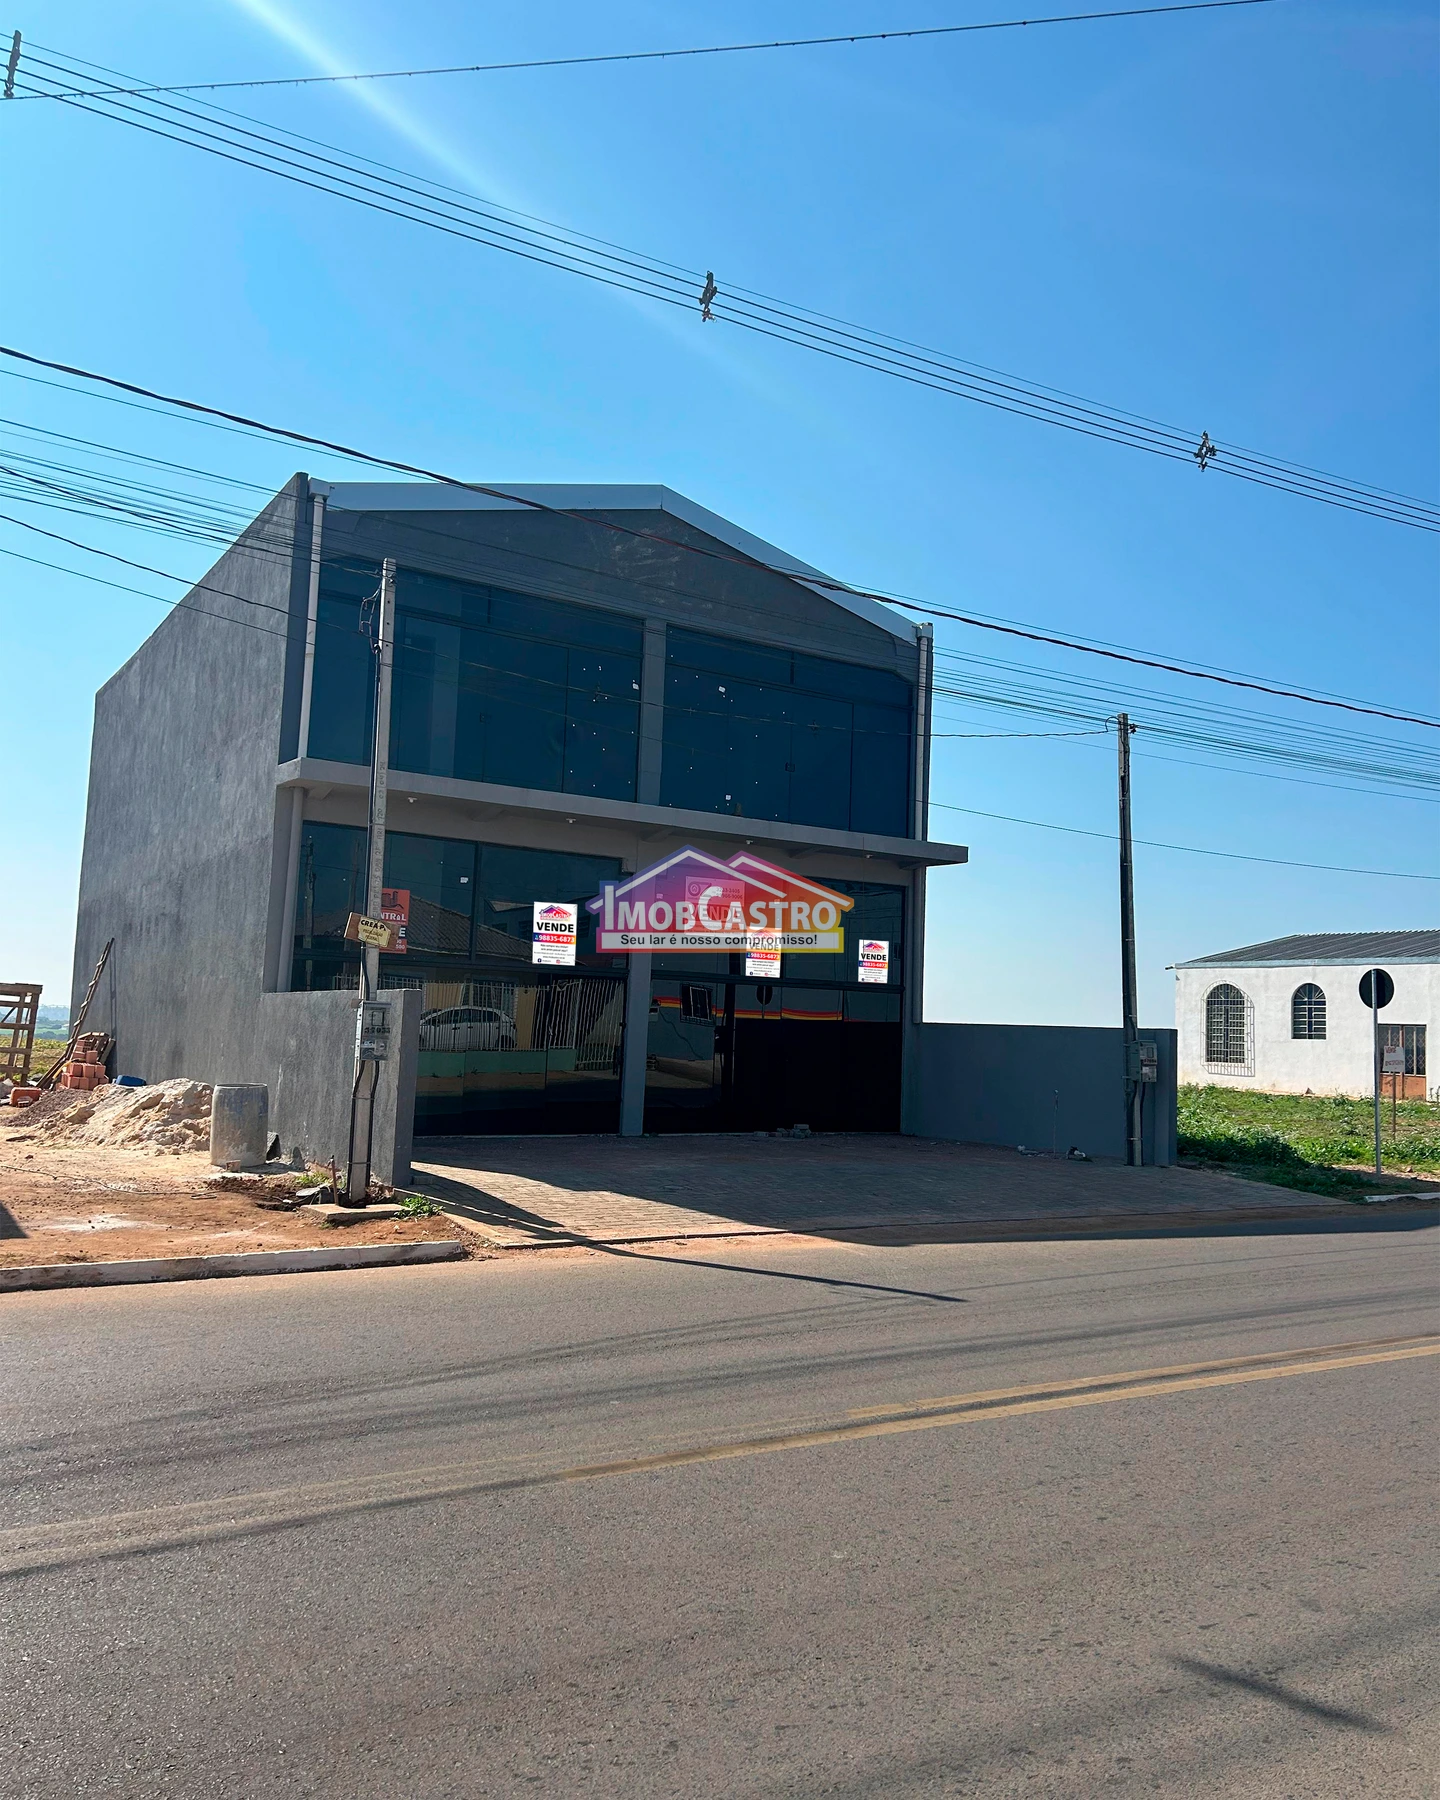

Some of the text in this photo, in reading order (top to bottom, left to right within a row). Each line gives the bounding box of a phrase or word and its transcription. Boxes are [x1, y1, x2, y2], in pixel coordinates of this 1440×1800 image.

[536, 921, 575, 933] VENDE
[538, 934, 575, 943] 98835-6873
[749, 942, 780, 951] VENDE
[860, 952, 887, 961] VENDE
